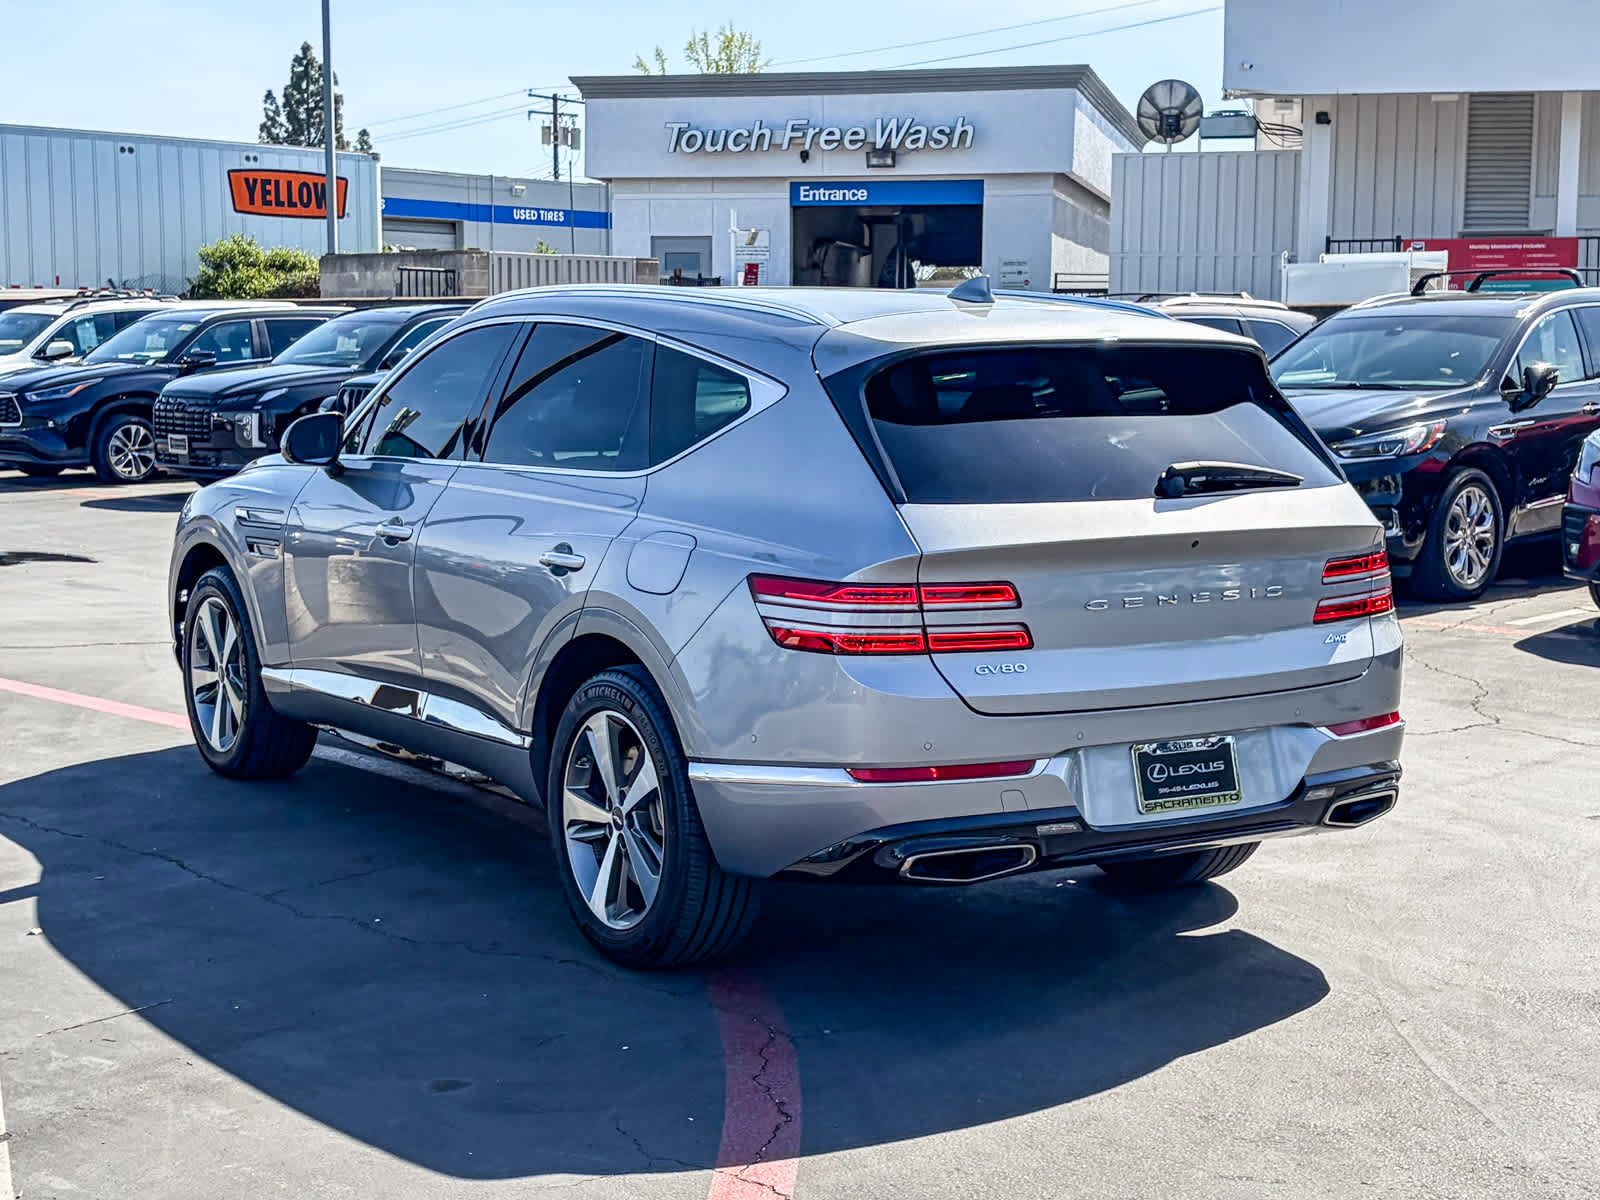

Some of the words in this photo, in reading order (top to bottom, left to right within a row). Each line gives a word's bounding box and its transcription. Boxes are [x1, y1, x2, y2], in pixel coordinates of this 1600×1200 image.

[664, 119, 771, 154] Touch
[781, 118, 866, 152] Free
[873, 115, 976, 151] Wash
[243, 177, 328, 210] YELLOW
[799, 185, 868, 201] Entrance
[513, 207, 538, 221] USED
[539, 209, 565, 222] TIRES
[1084, 585, 1284, 611] GENESIS
[975, 663, 1028, 675] GV80
[587, 686, 633, 710] MICHELIN
[1169, 760, 1225, 777] LEXUS
[1144, 793, 1240, 811] SACRAMENTO
